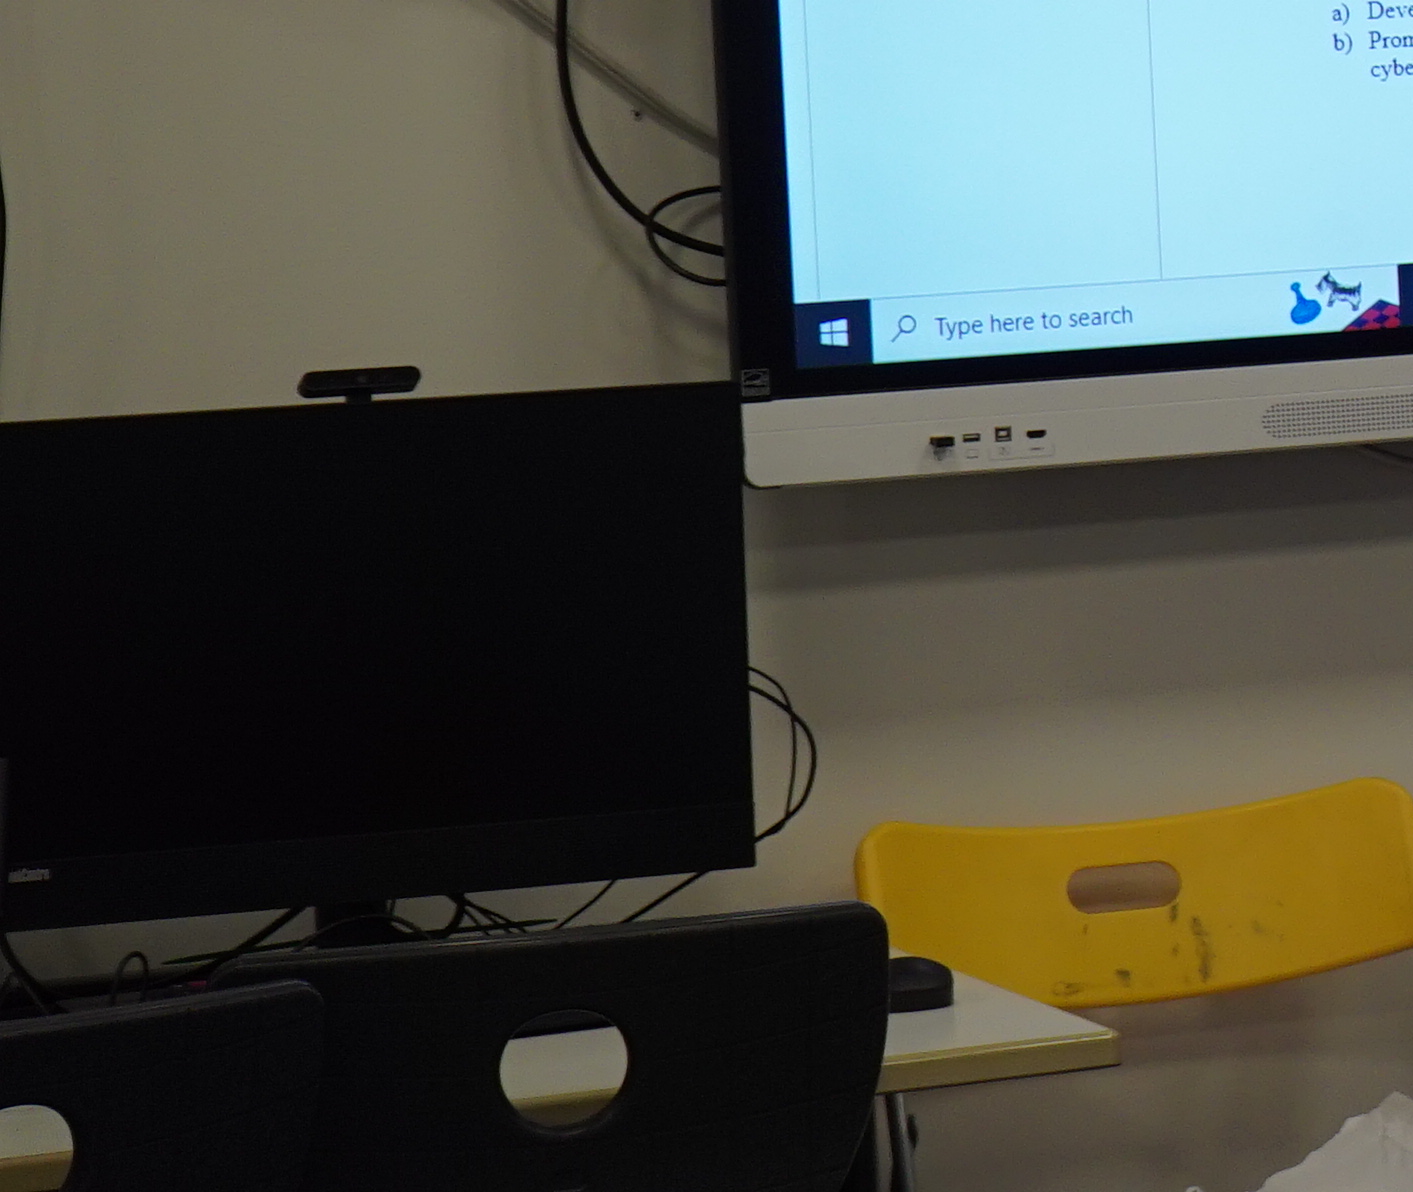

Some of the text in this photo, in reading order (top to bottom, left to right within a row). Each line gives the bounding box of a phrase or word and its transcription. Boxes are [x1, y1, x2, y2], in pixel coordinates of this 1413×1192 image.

[934, 305, 1133, 341] Type here to search
